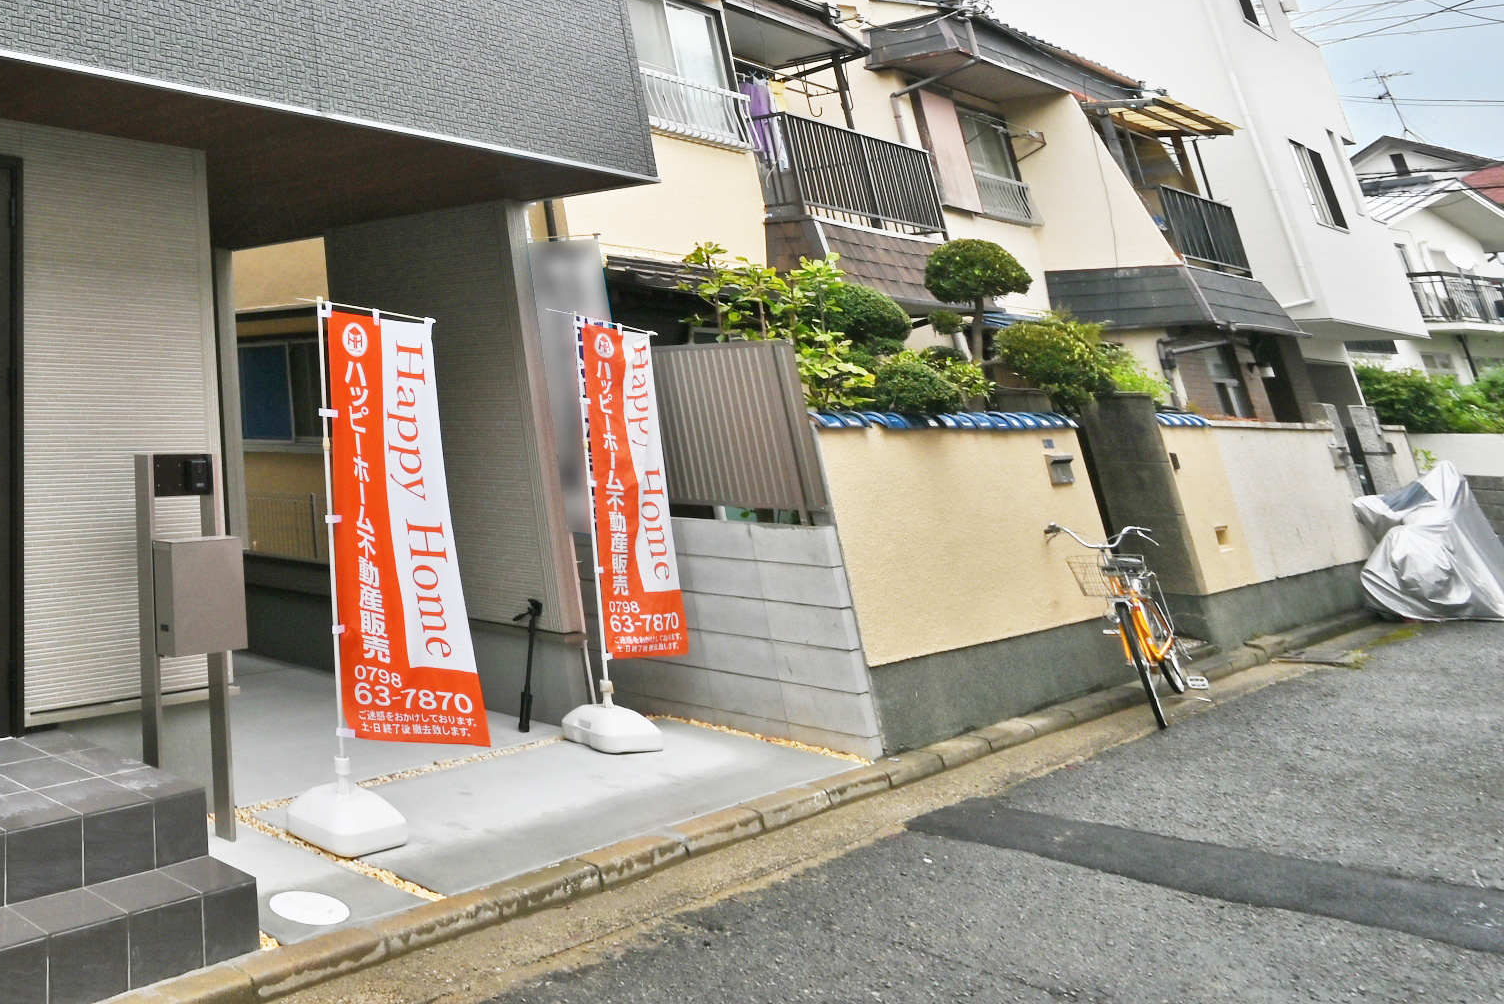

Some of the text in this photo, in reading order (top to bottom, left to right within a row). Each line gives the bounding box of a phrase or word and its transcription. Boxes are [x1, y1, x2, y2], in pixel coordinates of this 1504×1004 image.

[596, 360, 629, 596] ハッピーホーム不動産販売
[626, 345, 671, 581] Happ Home
[344, 360, 391, 664] ハッピーホーム不動産販売
[387, 342, 452, 660] Happy Home
[609, 600, 641, 614] 0798
[609, 611, 680, 633] 63-7870
[354, 665, 402, 688] 0798
[354, 682, 473, 714] 63-7870
[358, 709, 477, 728] ご迷惑をおかけしております。
